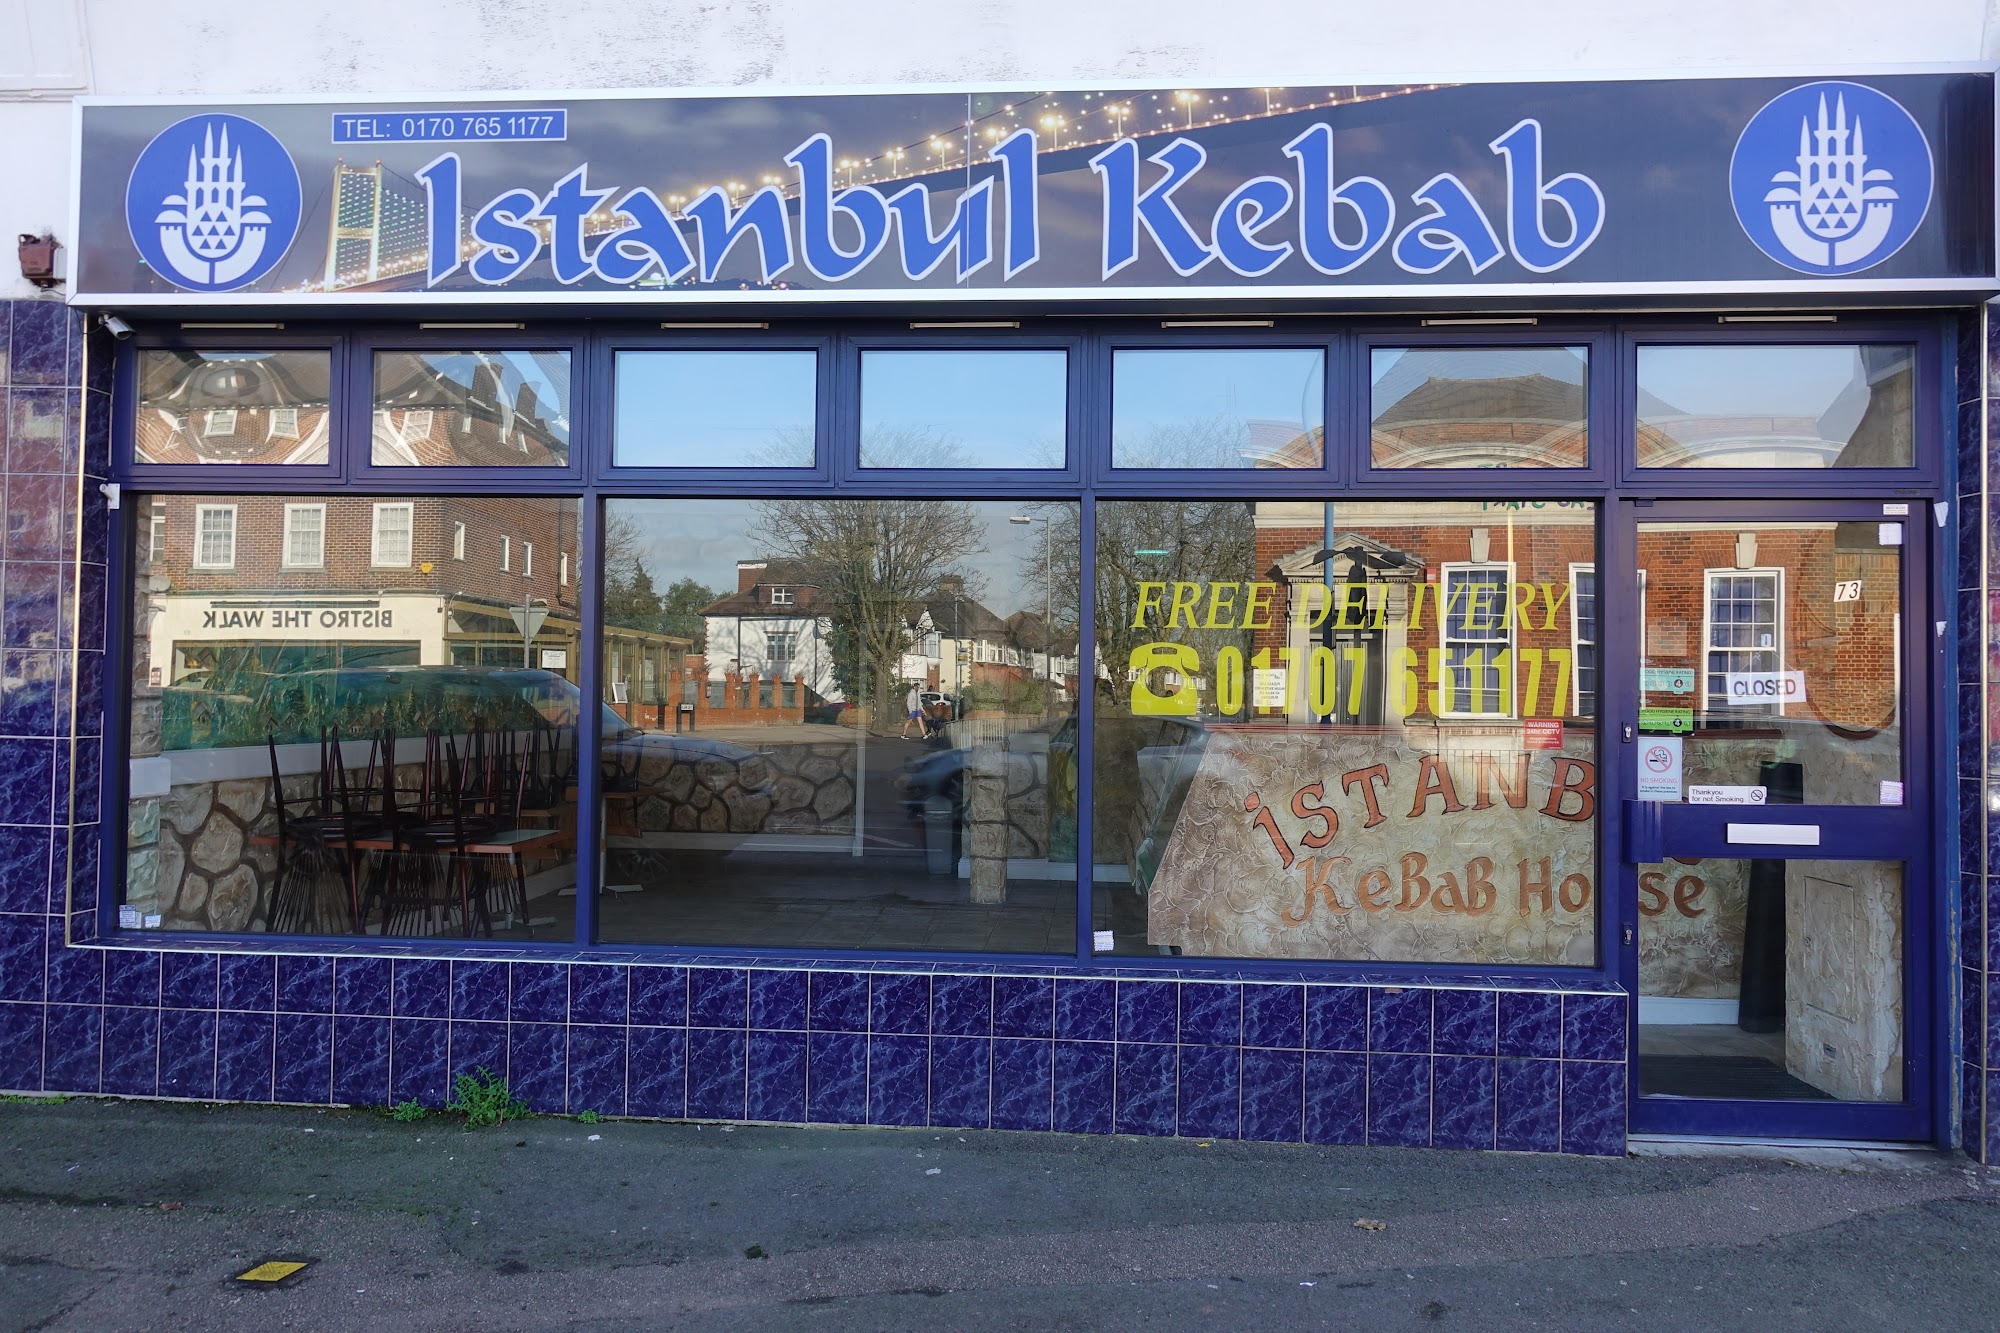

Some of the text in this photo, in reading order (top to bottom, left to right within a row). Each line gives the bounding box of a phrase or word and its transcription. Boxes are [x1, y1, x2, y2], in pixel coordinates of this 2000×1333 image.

[342, 116, 554, 138] TEL: 0170 765 1177
[414, 117, 1607, 286] Istanbul Kebab
[1129, 581, 1571, 631] FREE DELIVERY
[1837, 582, 1859, 600] 73
[1216, 645, 1572, 718] 01707 651177
[1733, 679, 1797, 697] CLOSED
[1715, 795, 1745, 803] Smoking
[1517, 857, 1708, 919] Hose
